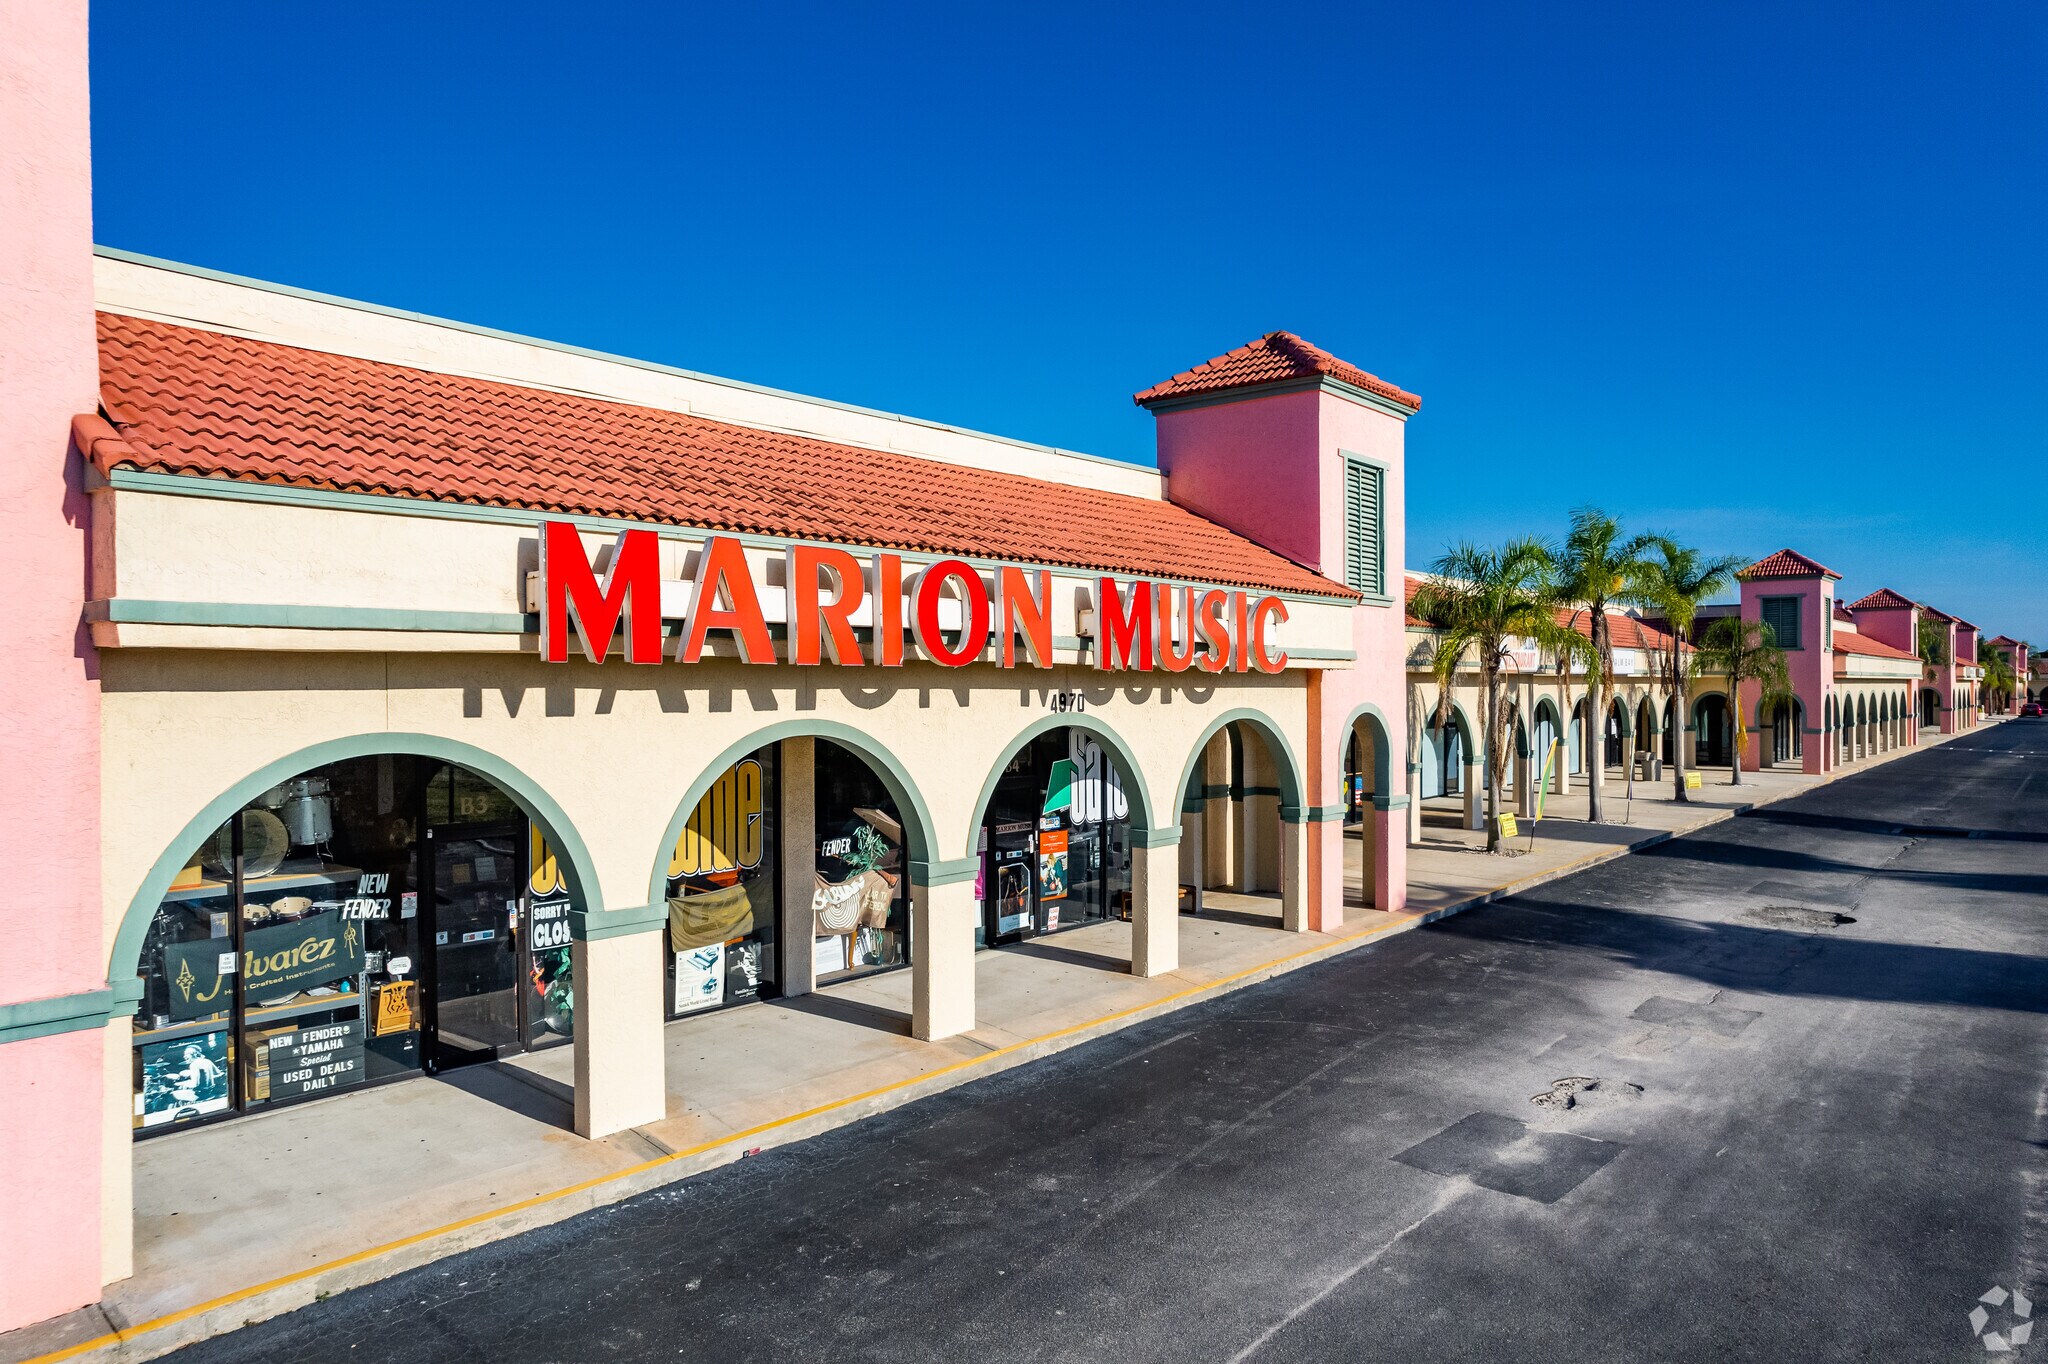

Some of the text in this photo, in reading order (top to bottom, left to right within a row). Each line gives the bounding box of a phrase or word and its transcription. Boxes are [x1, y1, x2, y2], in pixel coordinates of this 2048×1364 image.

[539, 521, 1288, 675] MARION MUSIC
[1050, 692, 1085, 713] 4970
[460, 796, 489, 815] B3
[821, 838, 851, 857] FENDER
[358, 873, 390, 894] NEW
[342, 898, 392, 920] FENDER
[533, 904, 562, 920] SORRY
[533, 919, 573, 948] CLOS
[249, 976, 284, 990] Crafted
[285, 961, 337, 981] Instruments
[269, 1026, 343, 1050] NEW FENDER
[300, 1038, 344, 1055] YAMAHA
[300, 1052, 332, 1067] Special
[283, 1060, 354, 1084] USED DEALS
[303, 1075, 337, 1092] DAILY
